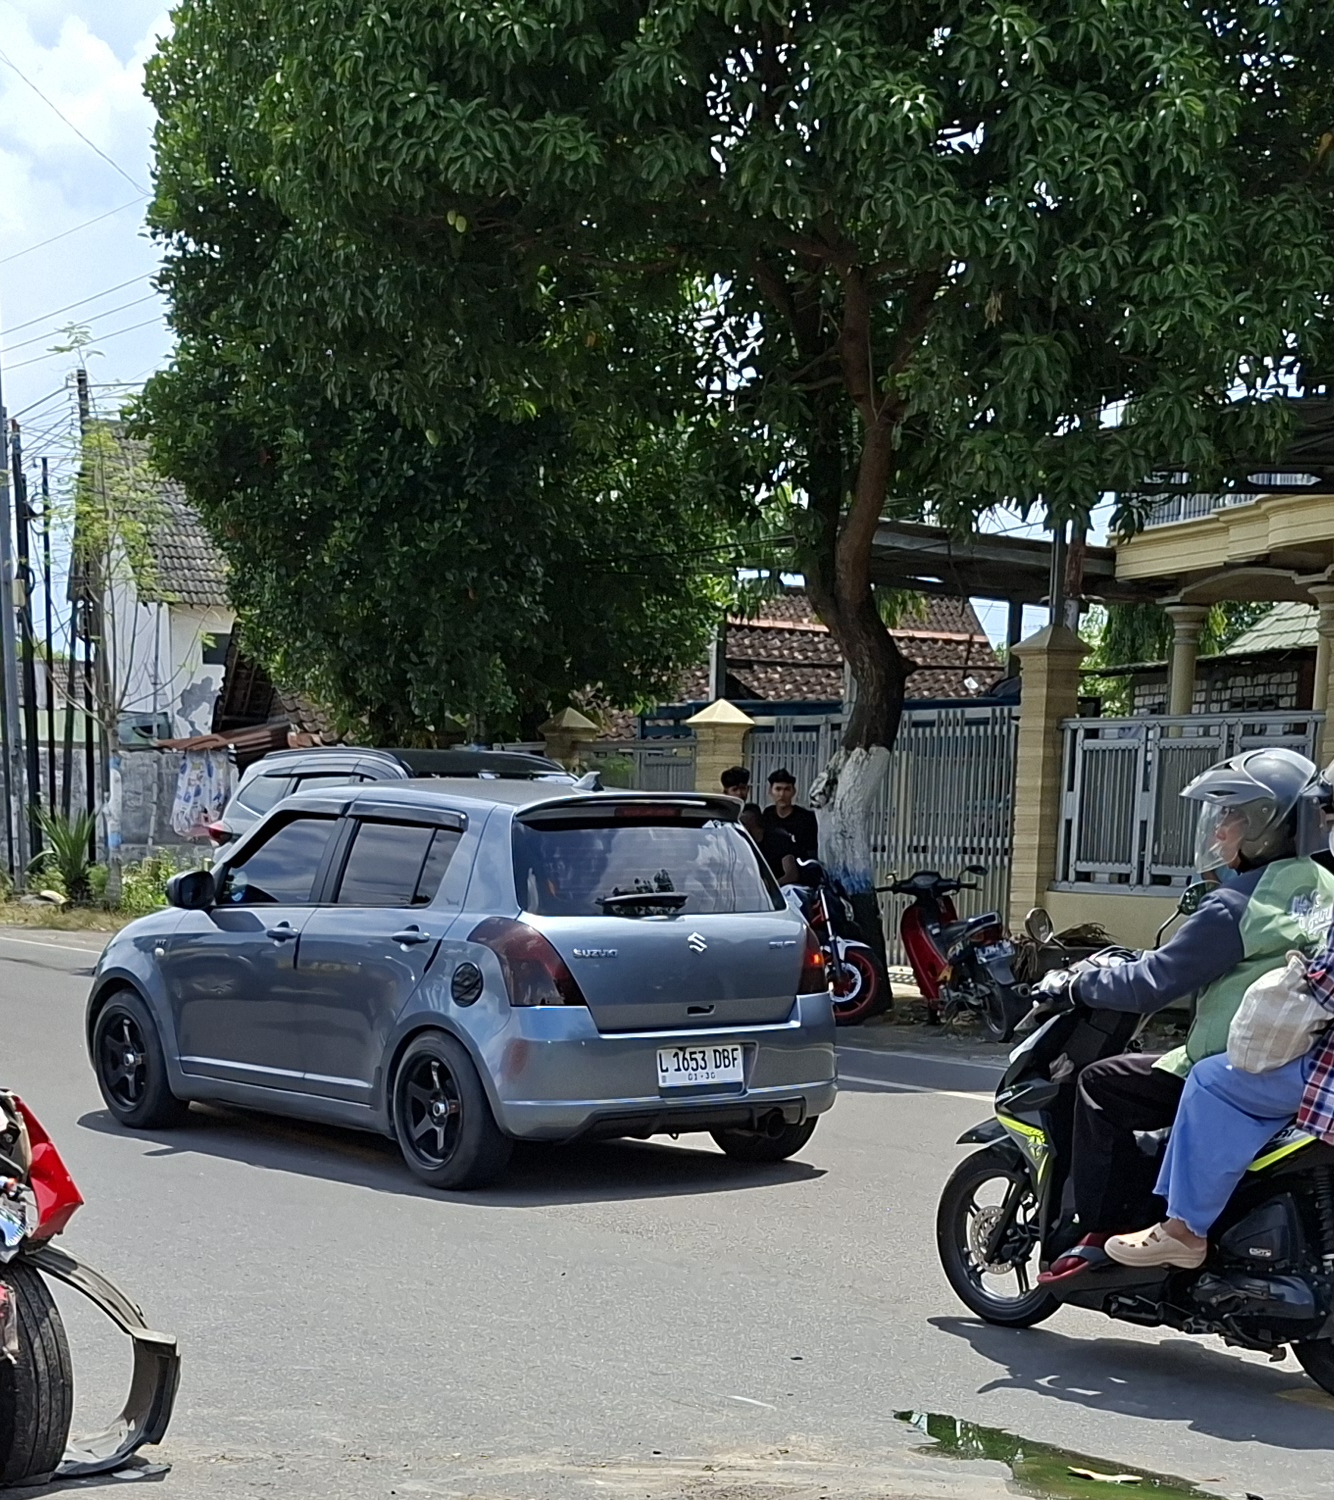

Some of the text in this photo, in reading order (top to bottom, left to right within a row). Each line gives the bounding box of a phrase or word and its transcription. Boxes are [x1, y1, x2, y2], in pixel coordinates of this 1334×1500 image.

[573, 948, 618, 959] SUZUKI
[659, 1048, 739, 1073] L 1653 DBF
